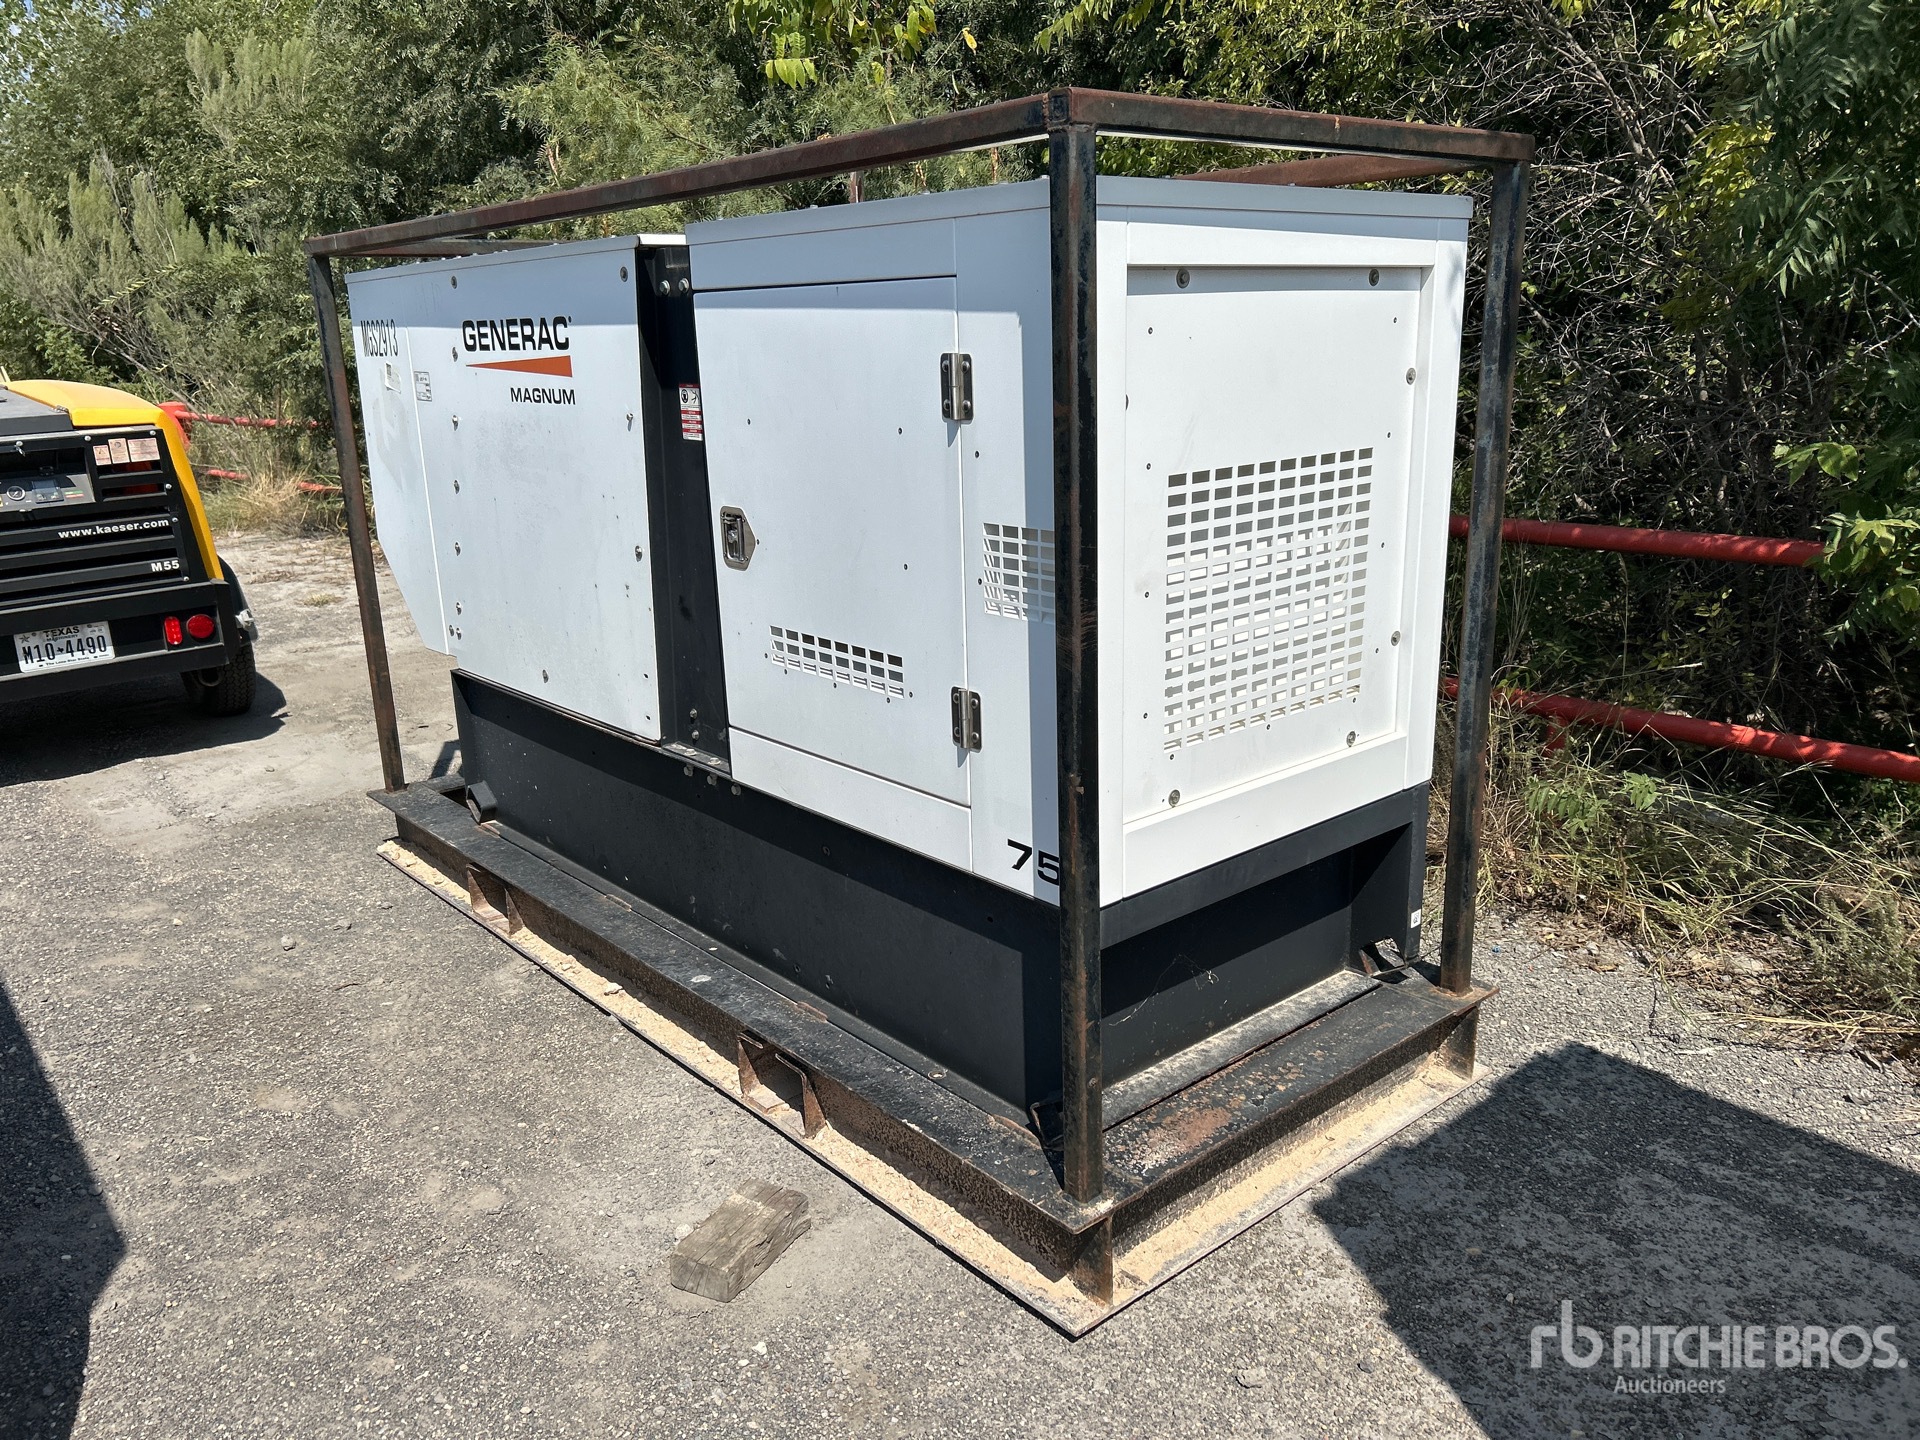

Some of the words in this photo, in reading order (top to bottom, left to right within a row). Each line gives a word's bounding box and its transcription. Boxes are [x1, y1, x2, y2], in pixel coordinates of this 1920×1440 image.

[360, 318, 398, 356] MGS2913
[462, 316, 570, 351] GENERAC
[510, 387, 575, 405] MAGNUM
[58, 519, 169, 538] www.kaeser.com
[43, 626, 79, 637] TEXAS
[1007, 838, 1060, 886] 75
